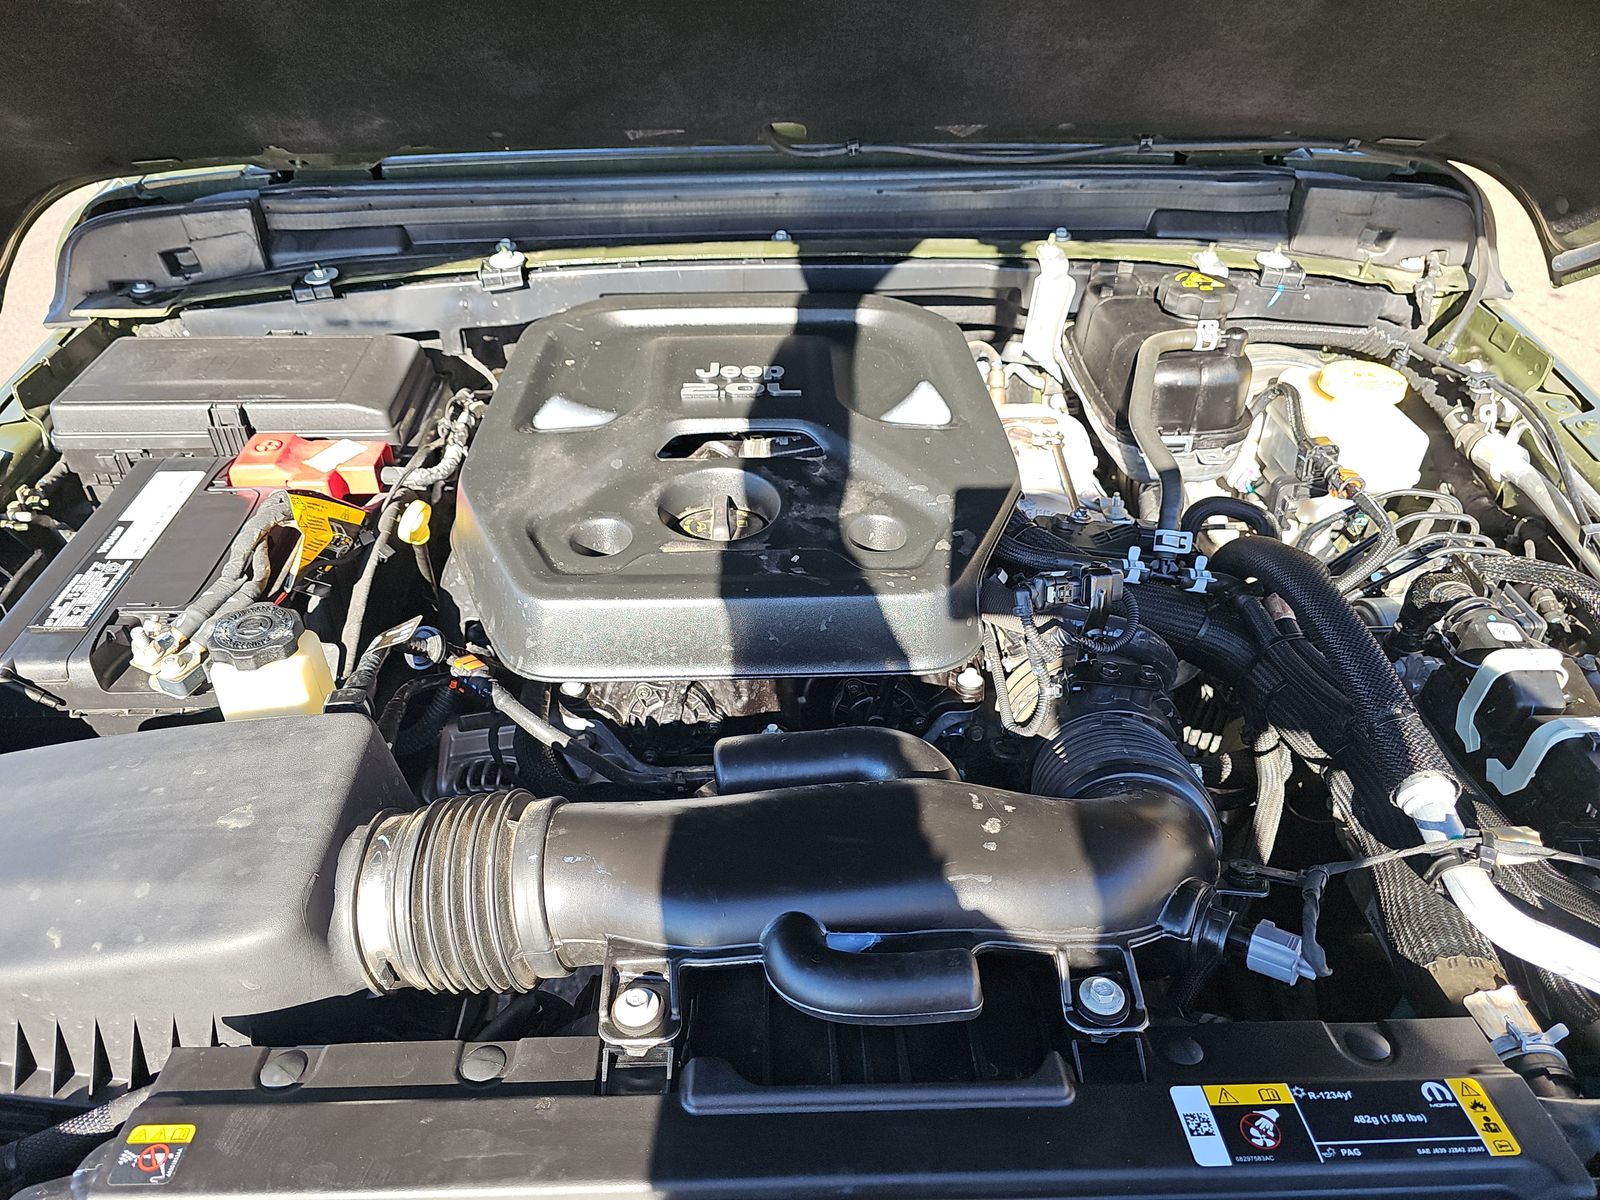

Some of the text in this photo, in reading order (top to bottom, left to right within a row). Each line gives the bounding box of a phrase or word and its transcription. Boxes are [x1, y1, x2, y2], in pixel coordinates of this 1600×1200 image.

[695, 362, 785, 381] Jeep
[681, 383, 802, 400] 2.0L
[1307, 1090, 1352, 1101] R-1234yf
[1406, 1113, 1428, 1123] lbs)
[1340, 1148, 1362, 1157] PAG
